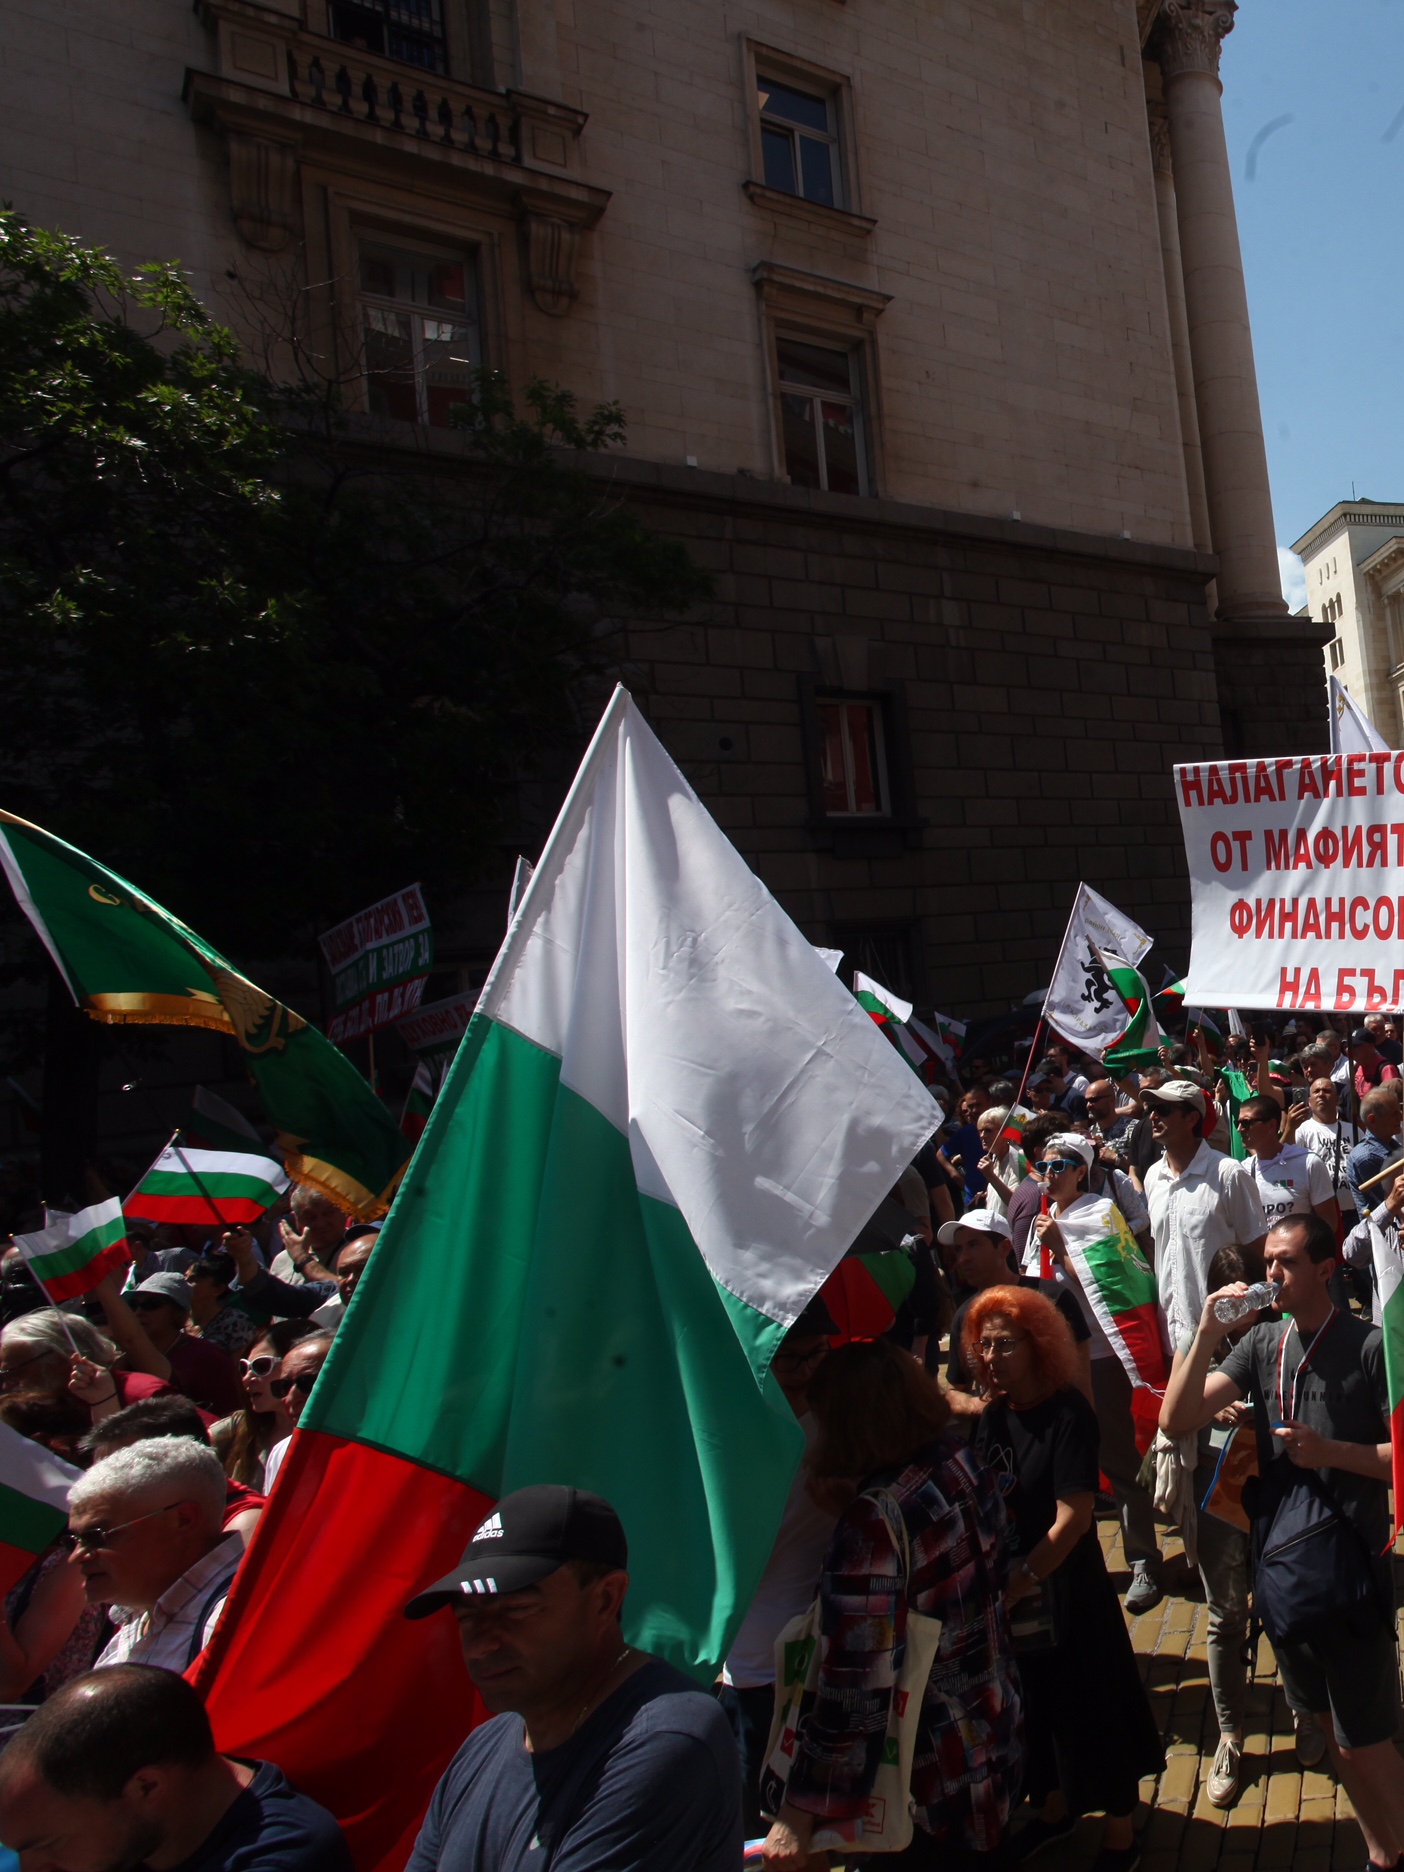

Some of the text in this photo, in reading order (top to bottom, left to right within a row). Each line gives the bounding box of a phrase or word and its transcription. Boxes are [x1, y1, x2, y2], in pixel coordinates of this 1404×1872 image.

[1212, 831, 1252, 872] ОТ
[382, 938, 415, 980] ЗАТВОР
[1277, 967, 1321, 1010] НА
[1318, 1136, 1350, 1148] WHN
